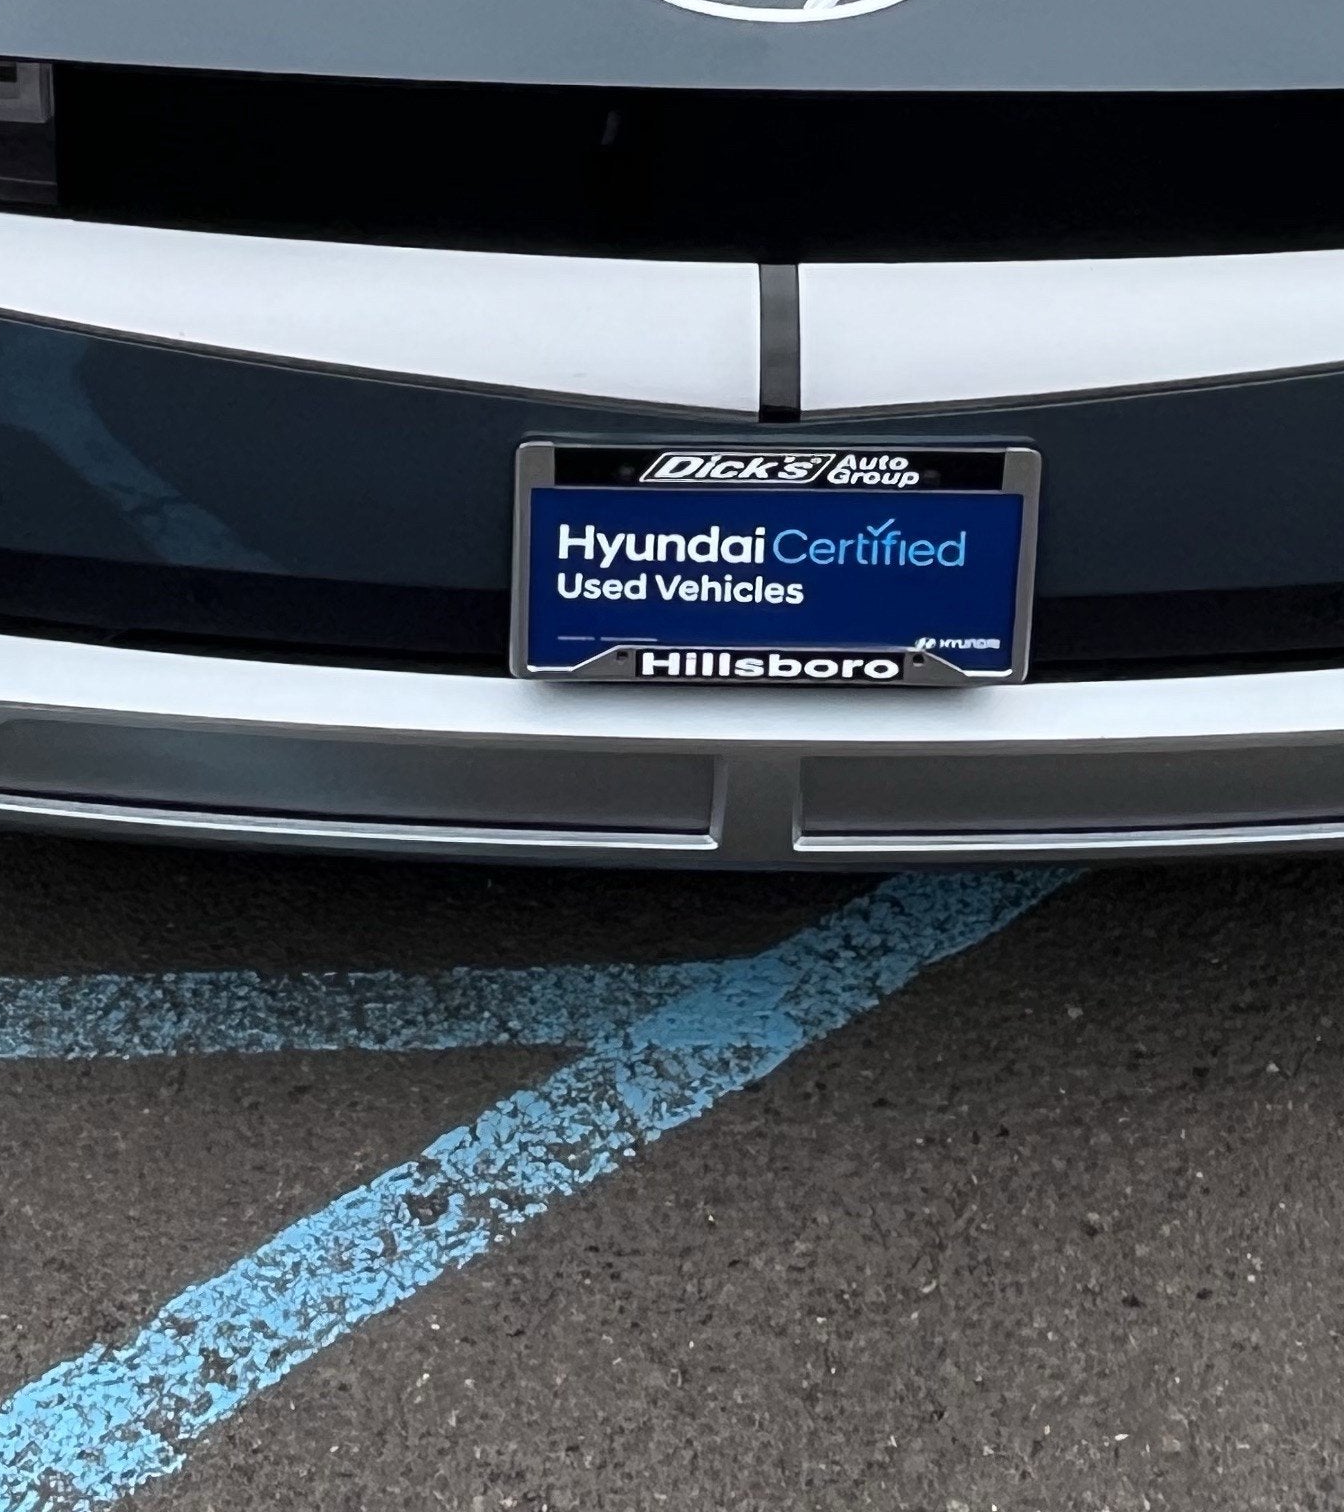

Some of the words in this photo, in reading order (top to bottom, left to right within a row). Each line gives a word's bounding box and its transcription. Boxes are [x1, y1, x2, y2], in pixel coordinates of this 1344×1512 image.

[654, 454, 814, 480] Dick's
[837, 453, 909, 471] Auto
[827, 467, 920, 488] Group
[558, 523, 764, 569] Hyundai
[773, 519, 966, 567] Certified
[558, 573, 646, 600] Used
[656, 574, 804, 605] Vehicles
[641, 651, 900, 679] Hillsboro
